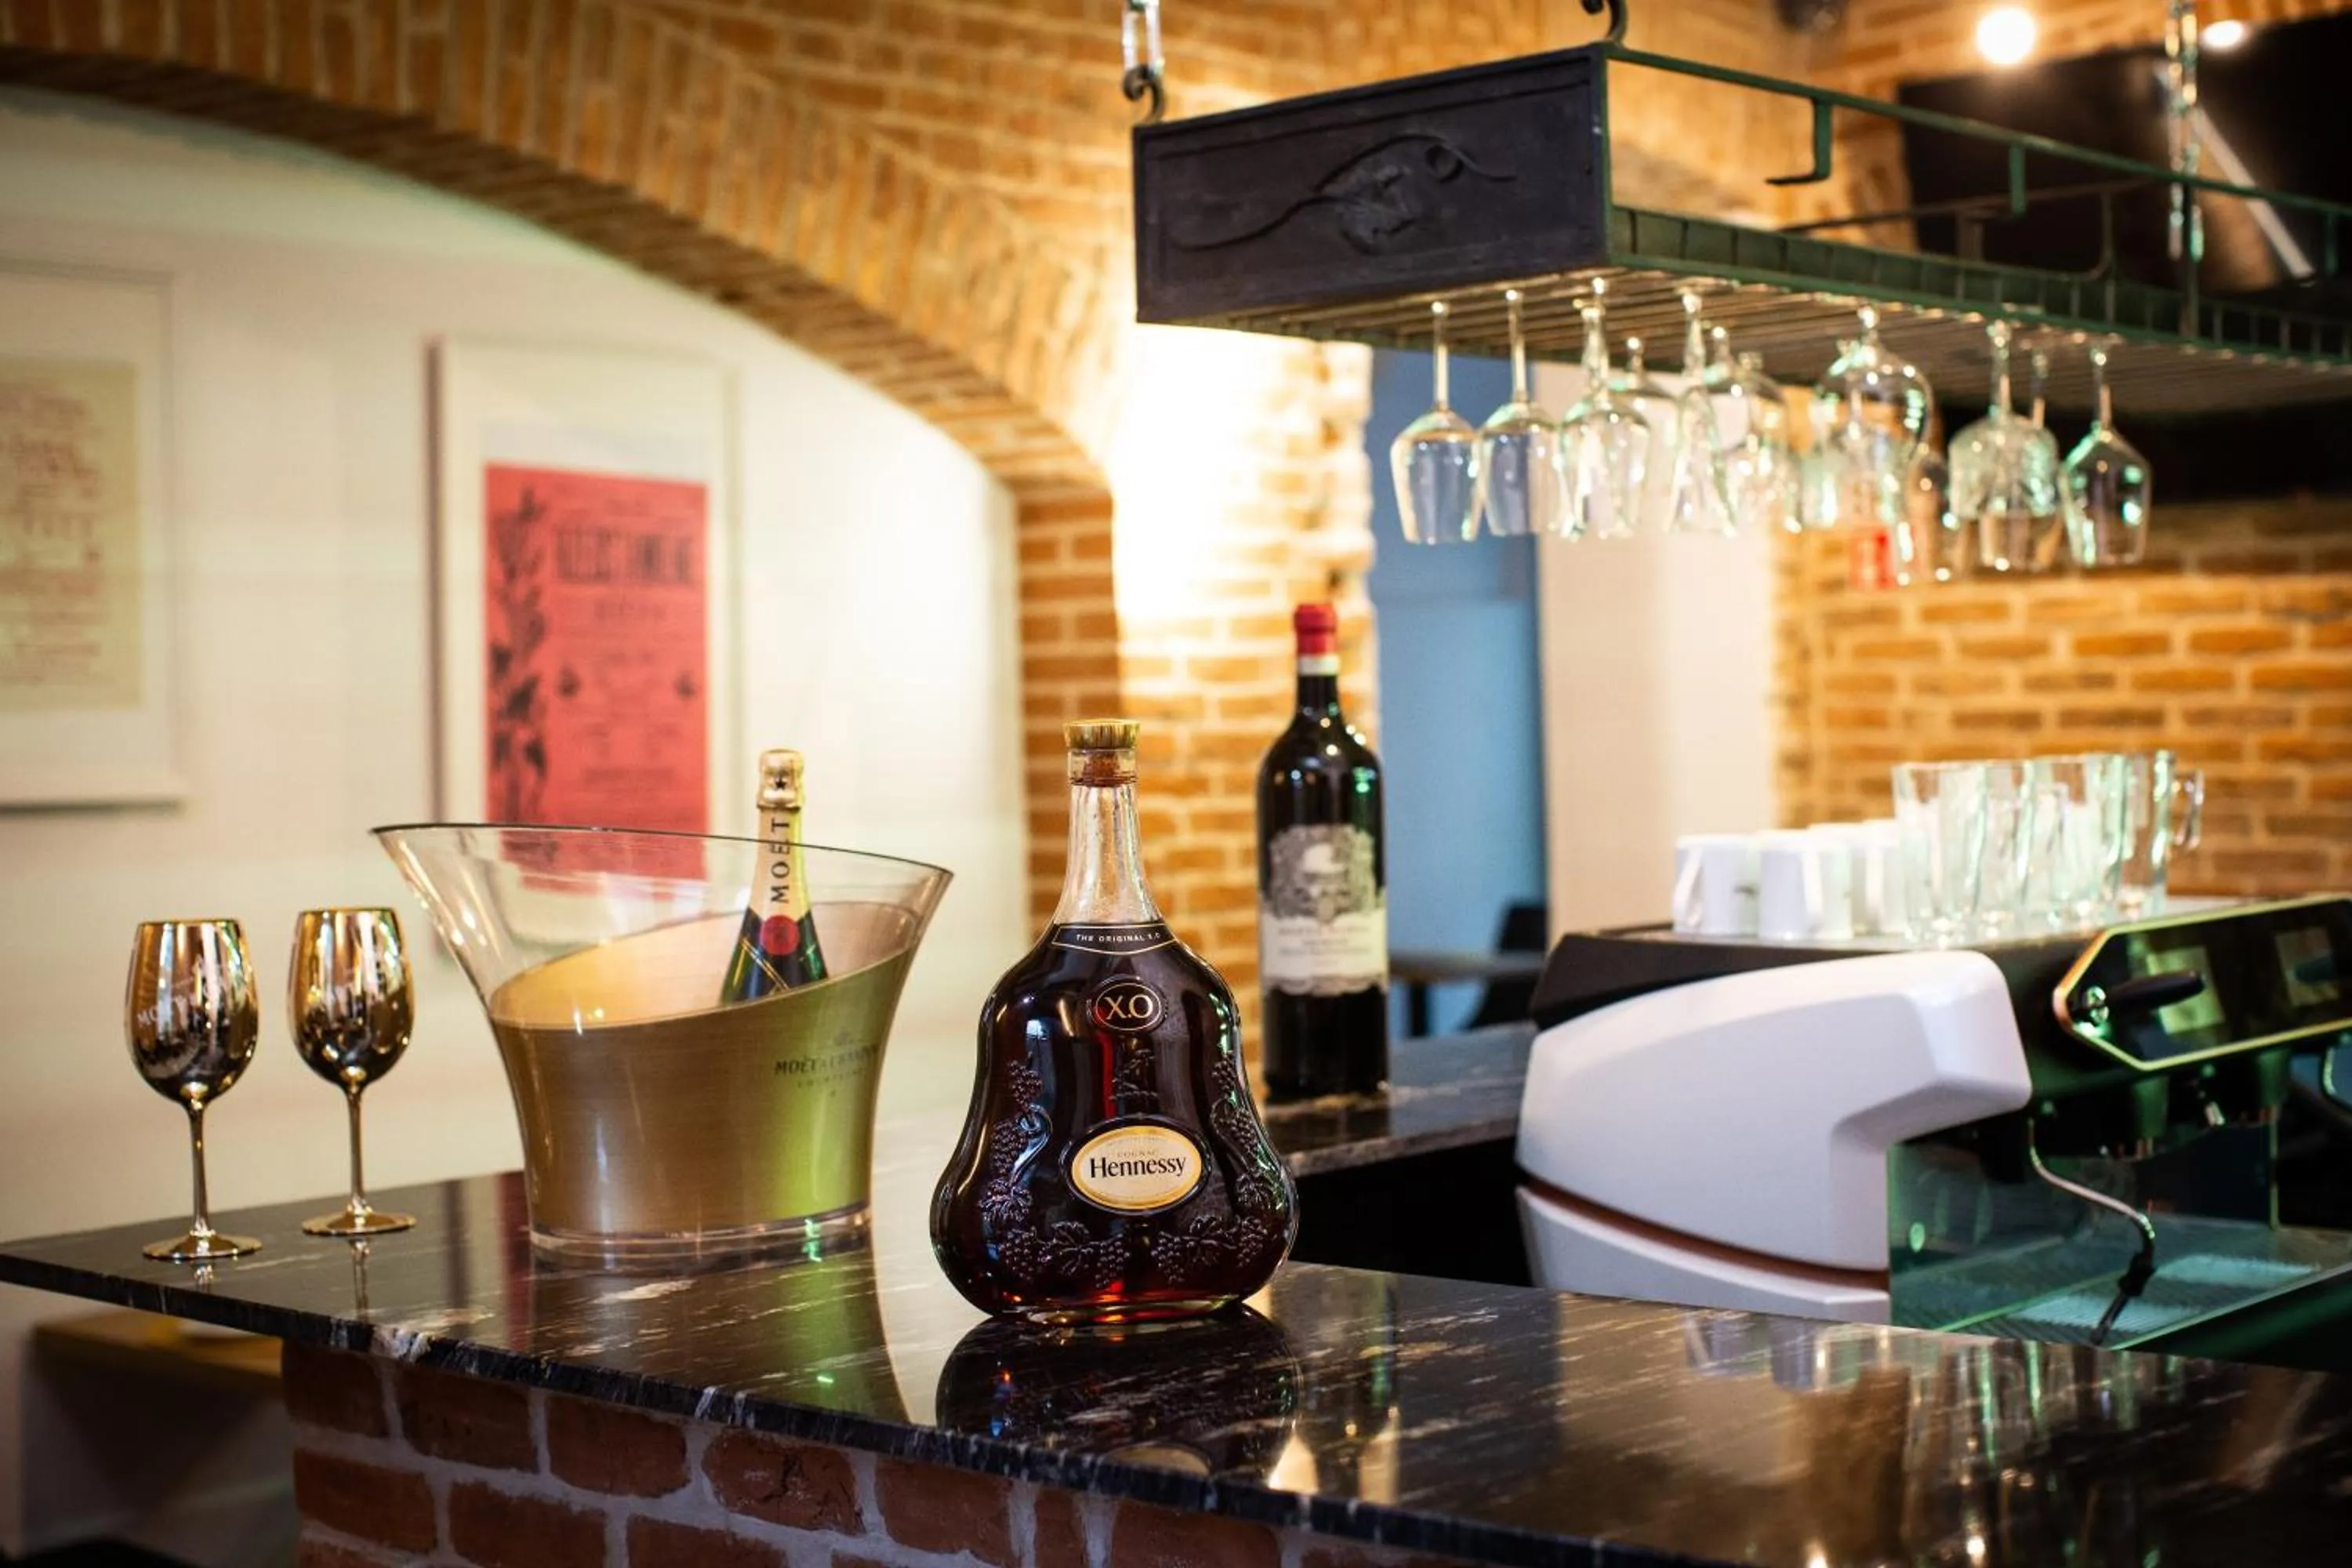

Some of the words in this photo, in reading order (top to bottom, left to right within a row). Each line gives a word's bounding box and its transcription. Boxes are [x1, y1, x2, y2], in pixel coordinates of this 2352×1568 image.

[1098, 934, 1145, 942] ORIGINAL
[1104, 994, 1153, 1020] X.O
[1090, 1157, 1186, 1178] Hennessy
